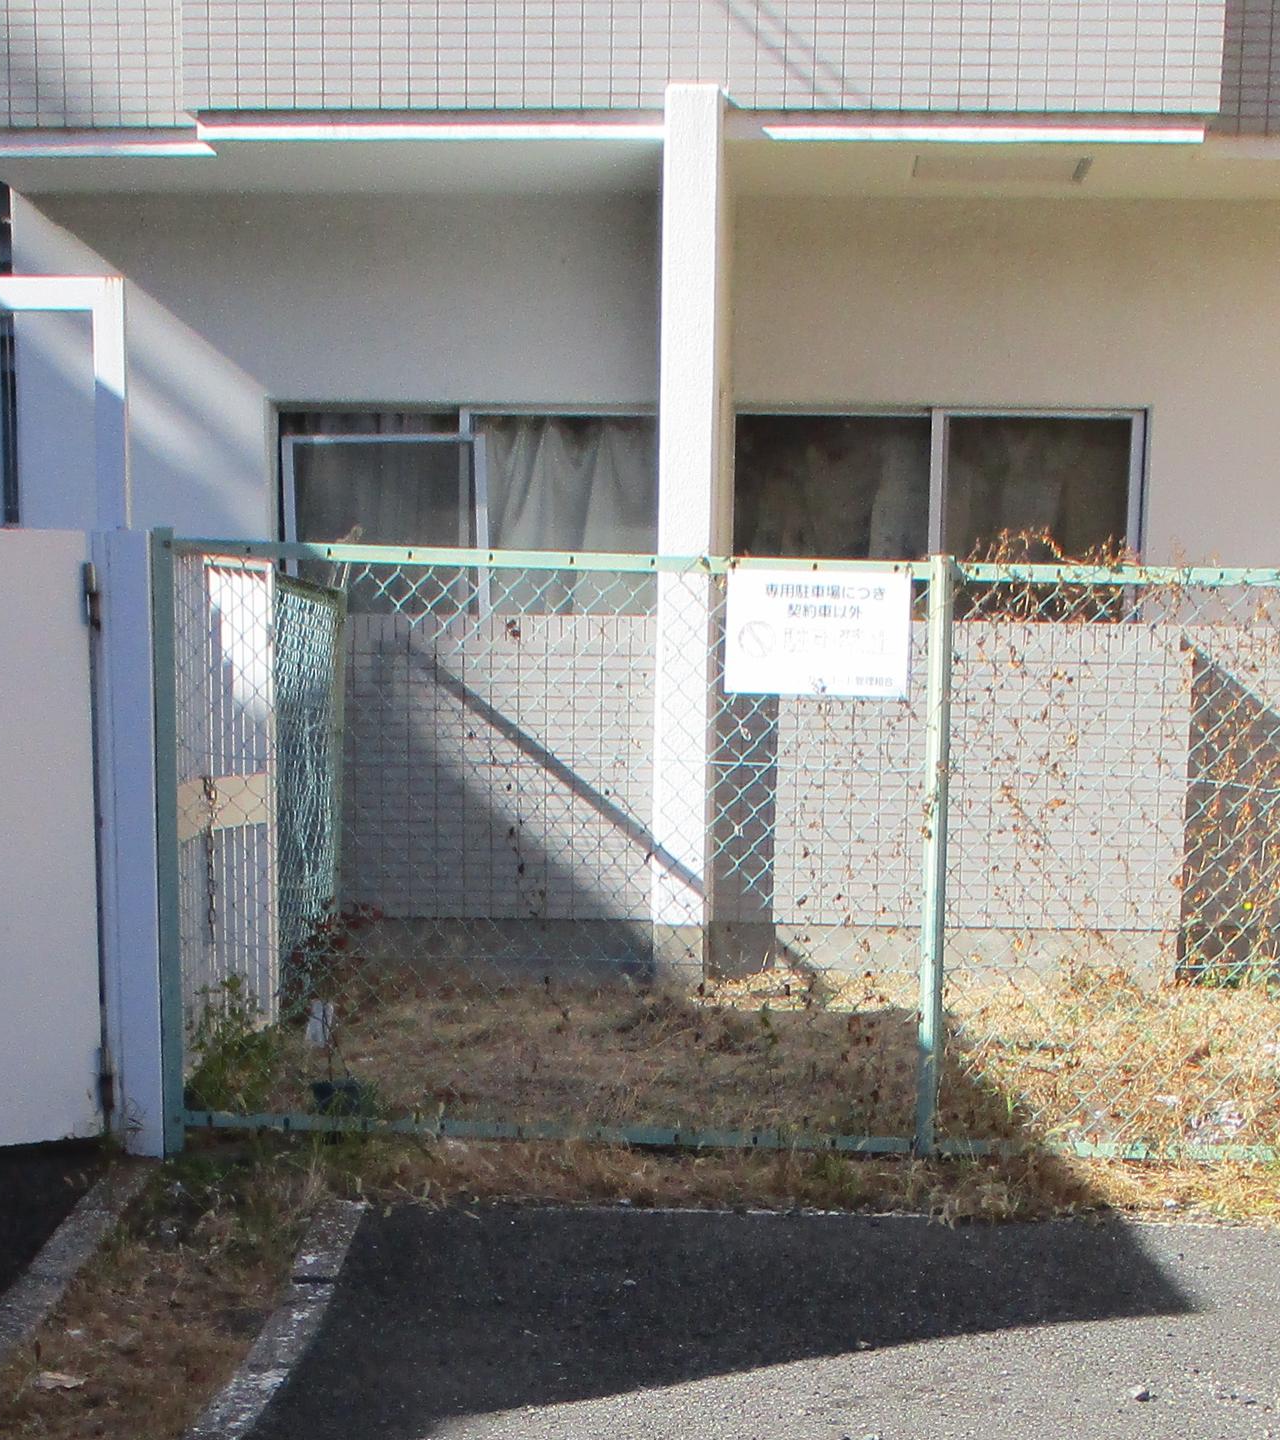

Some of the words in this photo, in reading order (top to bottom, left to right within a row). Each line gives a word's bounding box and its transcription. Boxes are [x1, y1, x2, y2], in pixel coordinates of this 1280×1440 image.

[765, 582, 887, 602] 専用駐車場につき
[787, 603, 863, 620] 契約車以外
